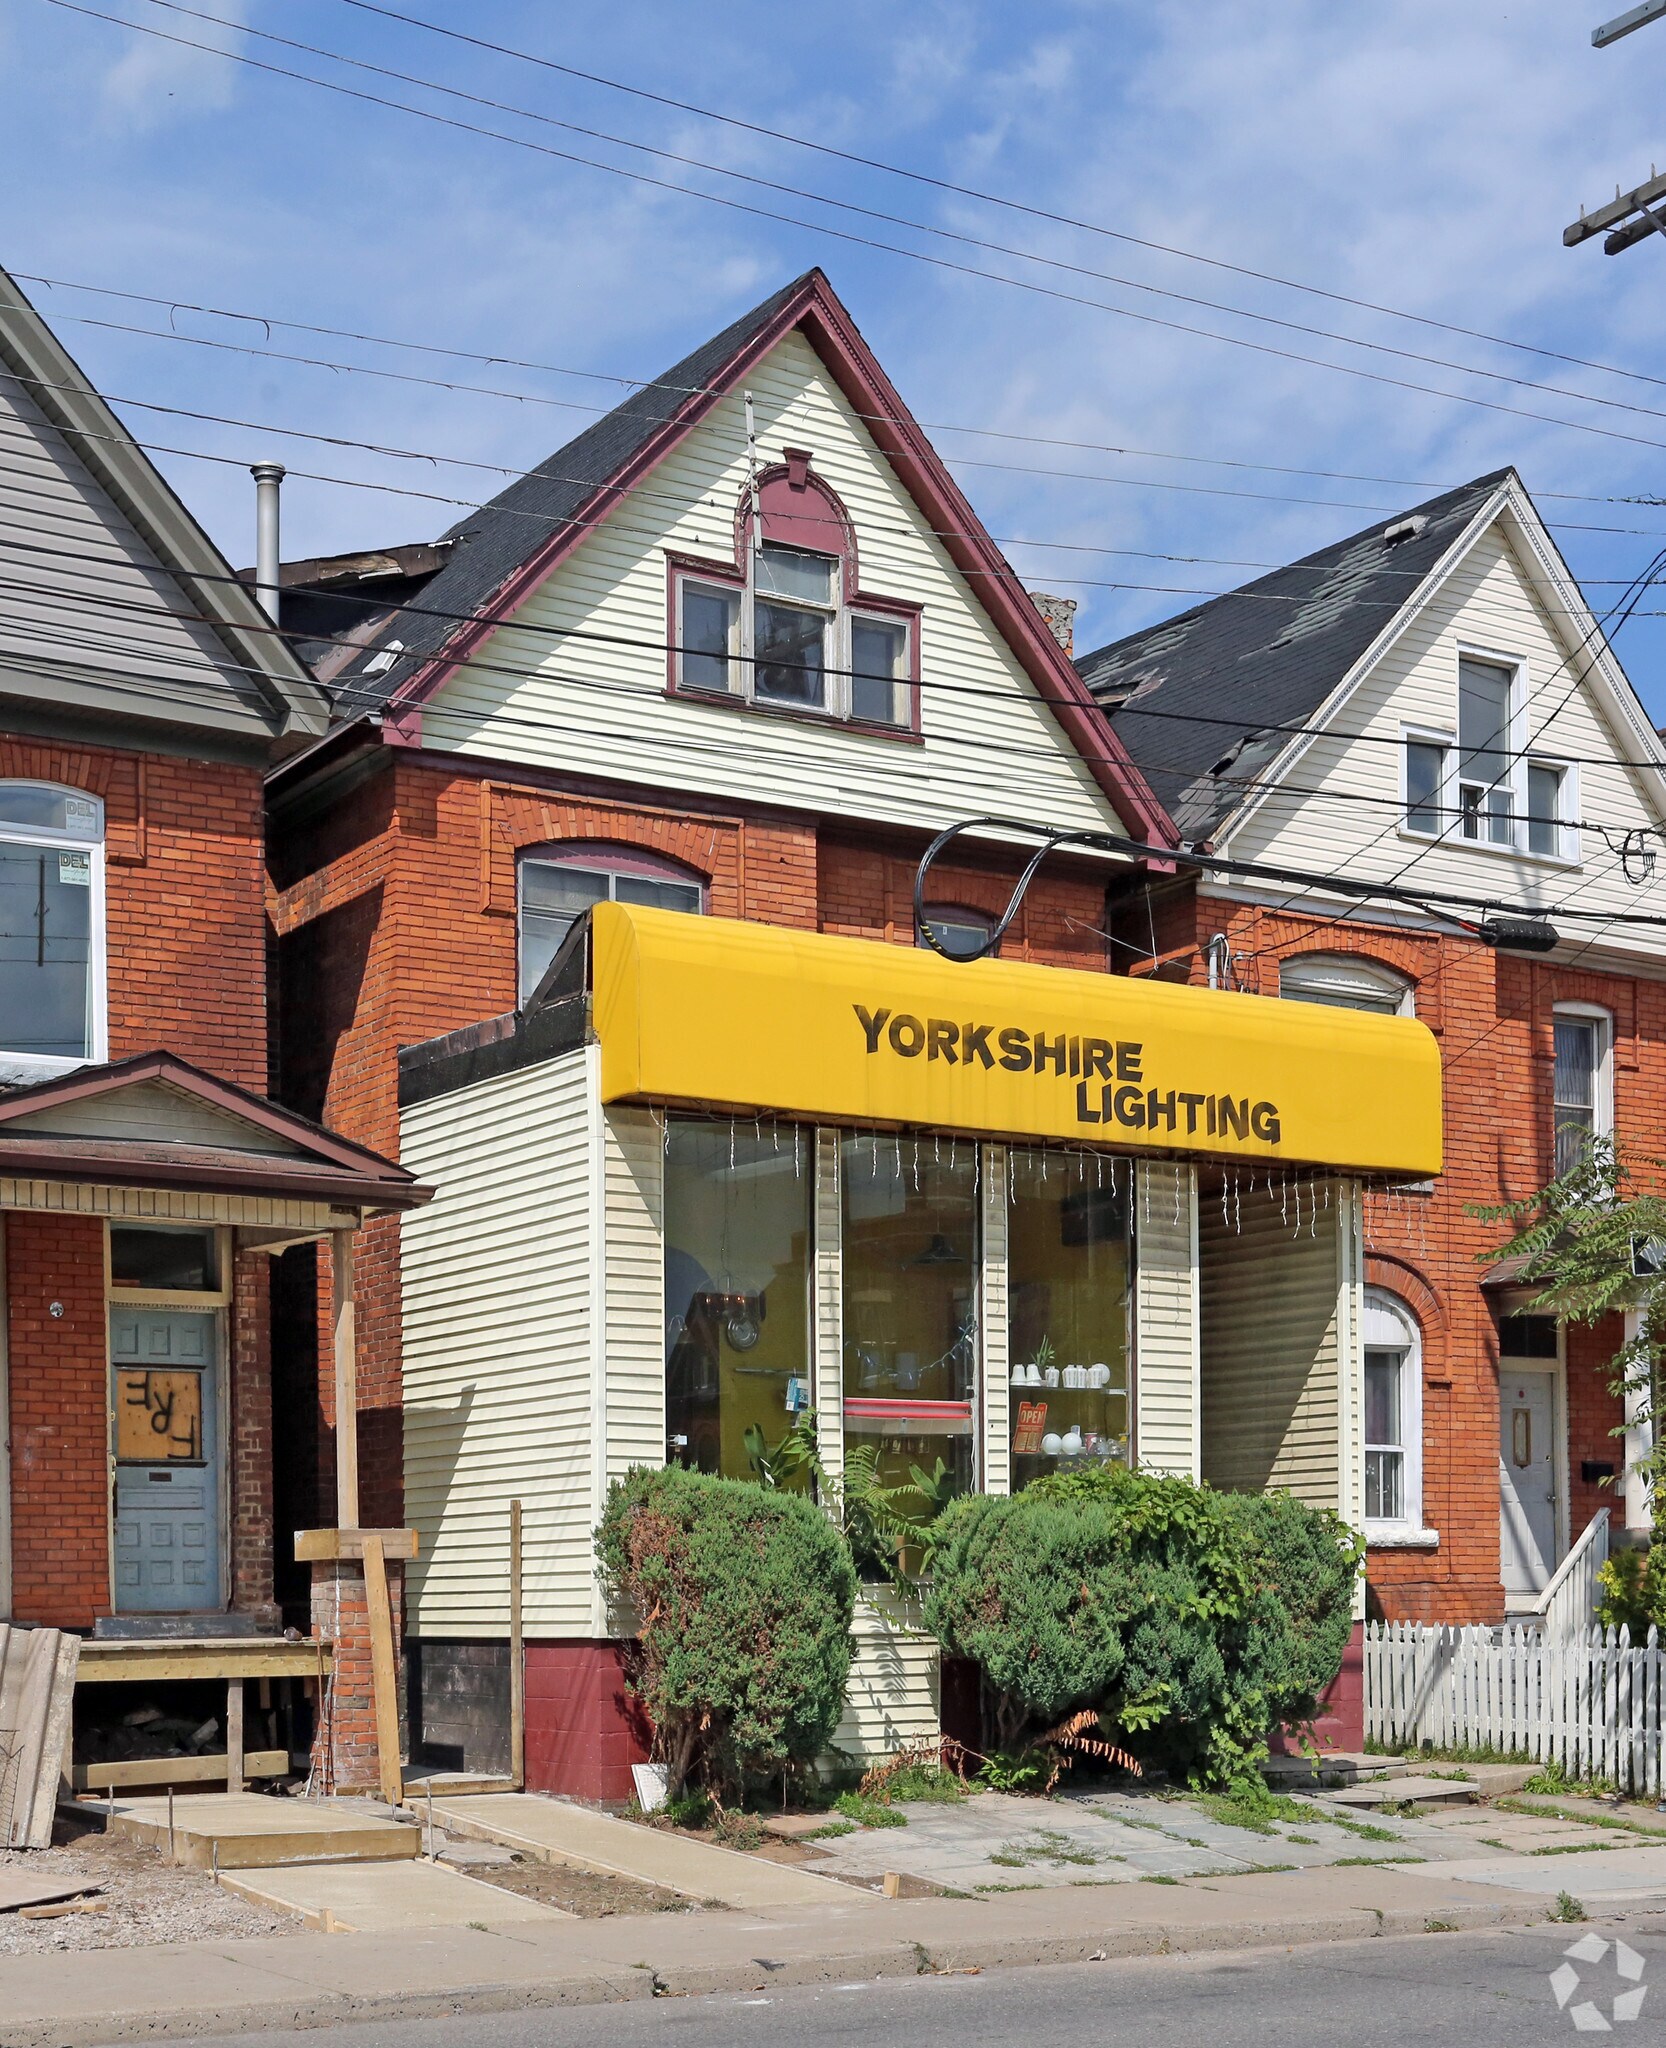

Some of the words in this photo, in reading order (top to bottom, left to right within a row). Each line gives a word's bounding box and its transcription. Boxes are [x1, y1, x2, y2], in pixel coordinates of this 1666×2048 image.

[66, 801, 94, 817] DEL
[60, 853, 88, 869] DEL
[852, 1004, 1143, 1083] YORKSHIRE
[1076, 1080, 1281, 1145] LIGHTING
[1020, 1410, 1044, 1423] OPEN
